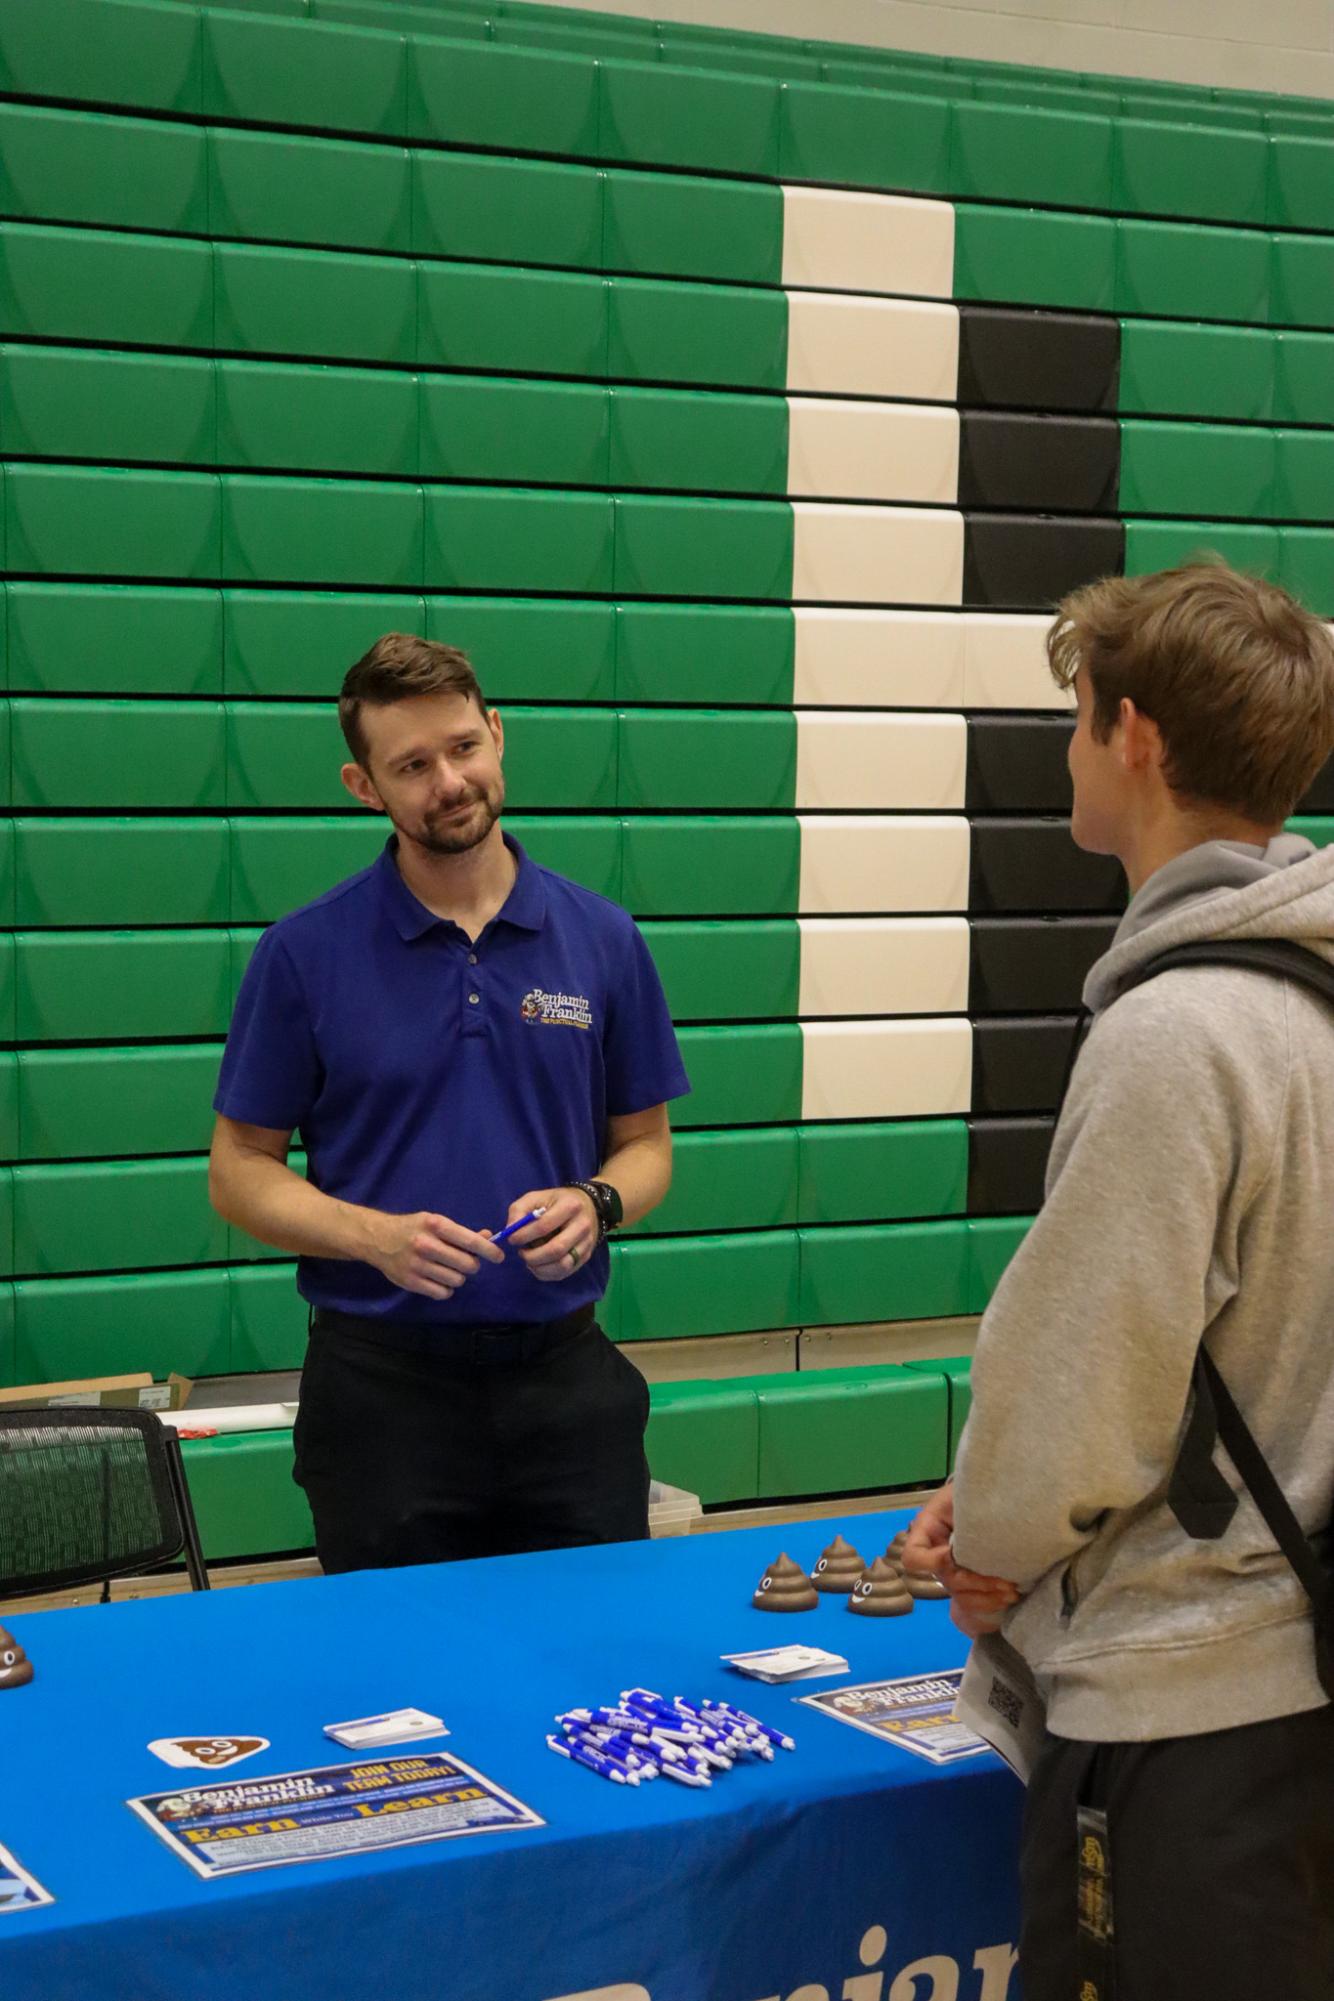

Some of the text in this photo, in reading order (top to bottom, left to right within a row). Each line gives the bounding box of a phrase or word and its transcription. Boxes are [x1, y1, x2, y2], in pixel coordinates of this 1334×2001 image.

[533, 989, 589, 1009] Benjamin
[541, 1004, 592, 1023] Franklin
[845, 1680, 952, 1701] Benjamin
[343, 1765, 456, 1792] TEAM TODAY!
[352, 1758, 429, 1779] JOIN OUR
[181, 1777, 315, 1803] Benjamin
[213, 1784, 336, 1809] Franklin
[181, 1817, 301, 1843] Earn
[353, 1788, 488, 1818] Learn
